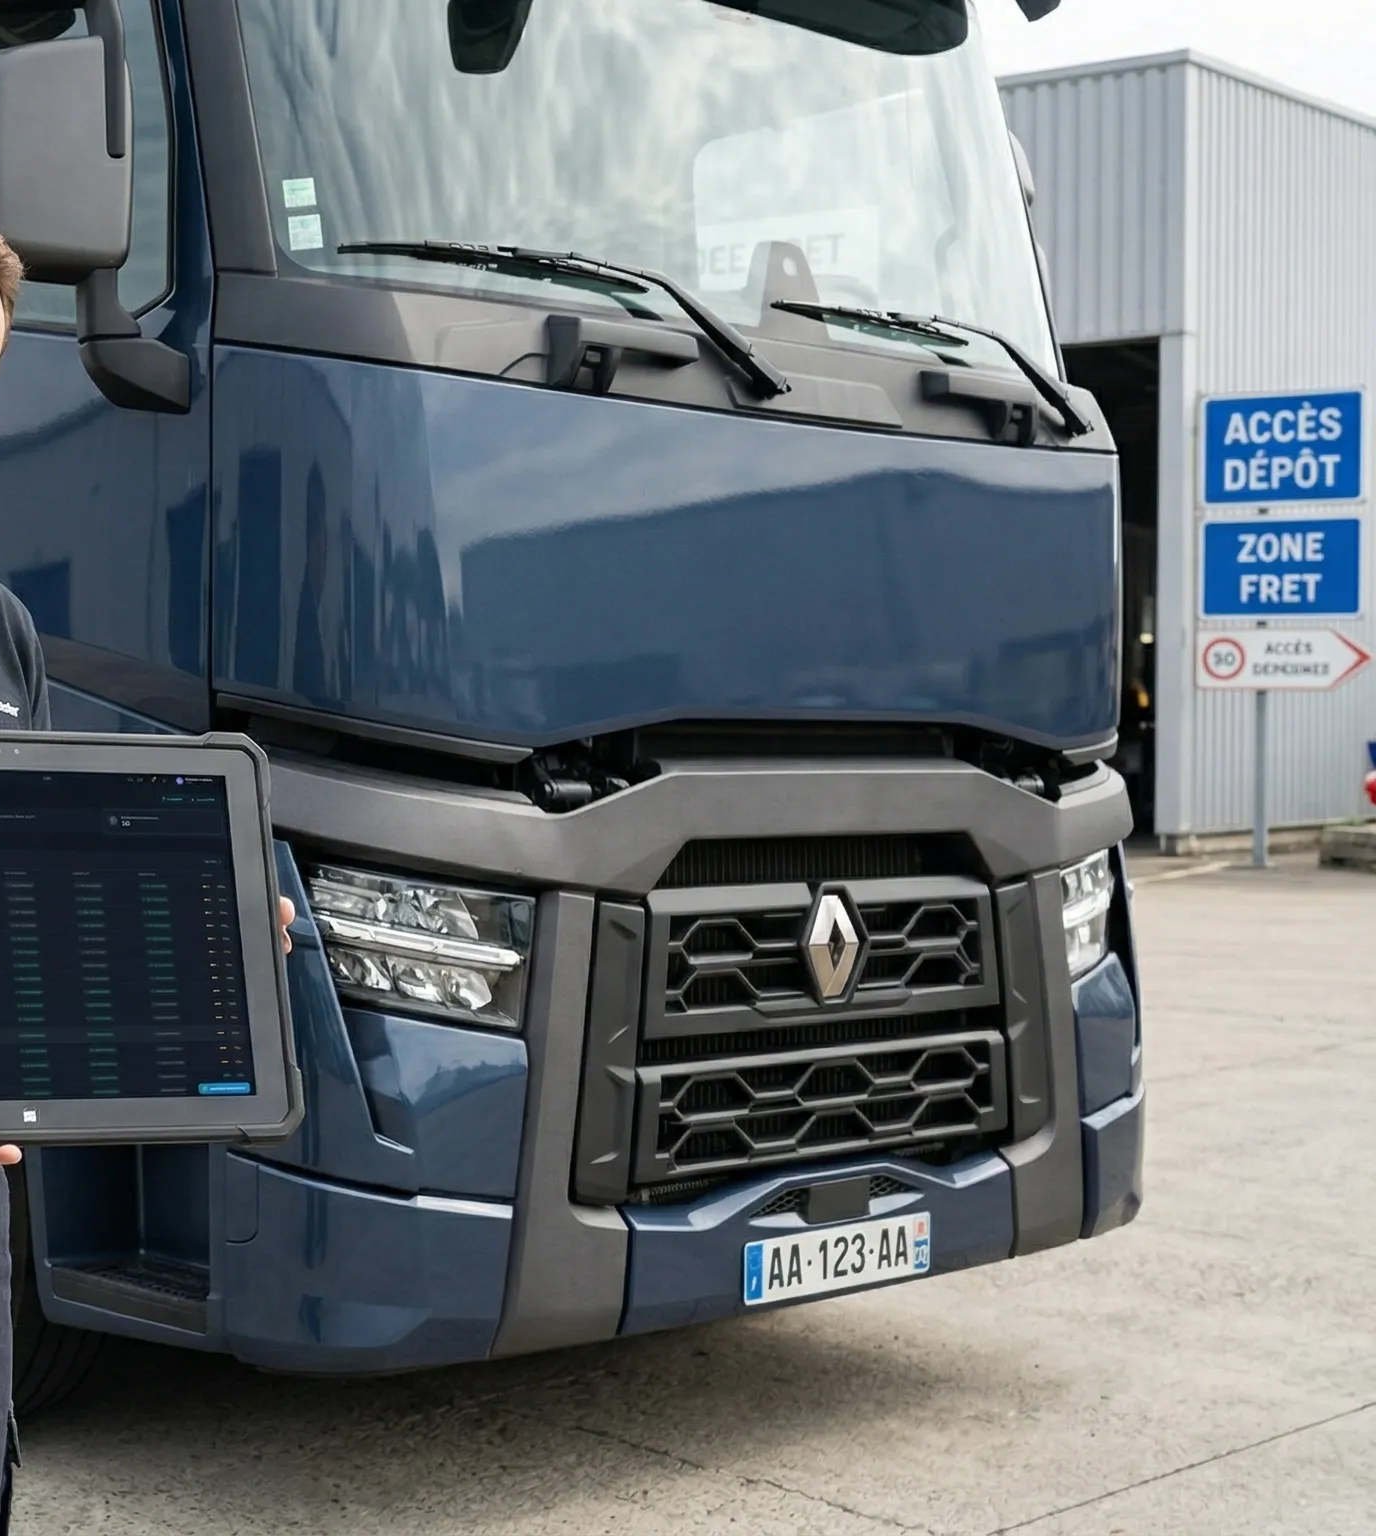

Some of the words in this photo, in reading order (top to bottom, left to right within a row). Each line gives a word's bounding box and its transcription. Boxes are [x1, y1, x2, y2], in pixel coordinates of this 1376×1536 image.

[1224, 401, 1342, 445] ACCÈS
[1224, 448, 1342, 491] DÉPÔT
[1236, 532, 1325, 563] ZONE
[1240, 573, 1322, 603] FRET
